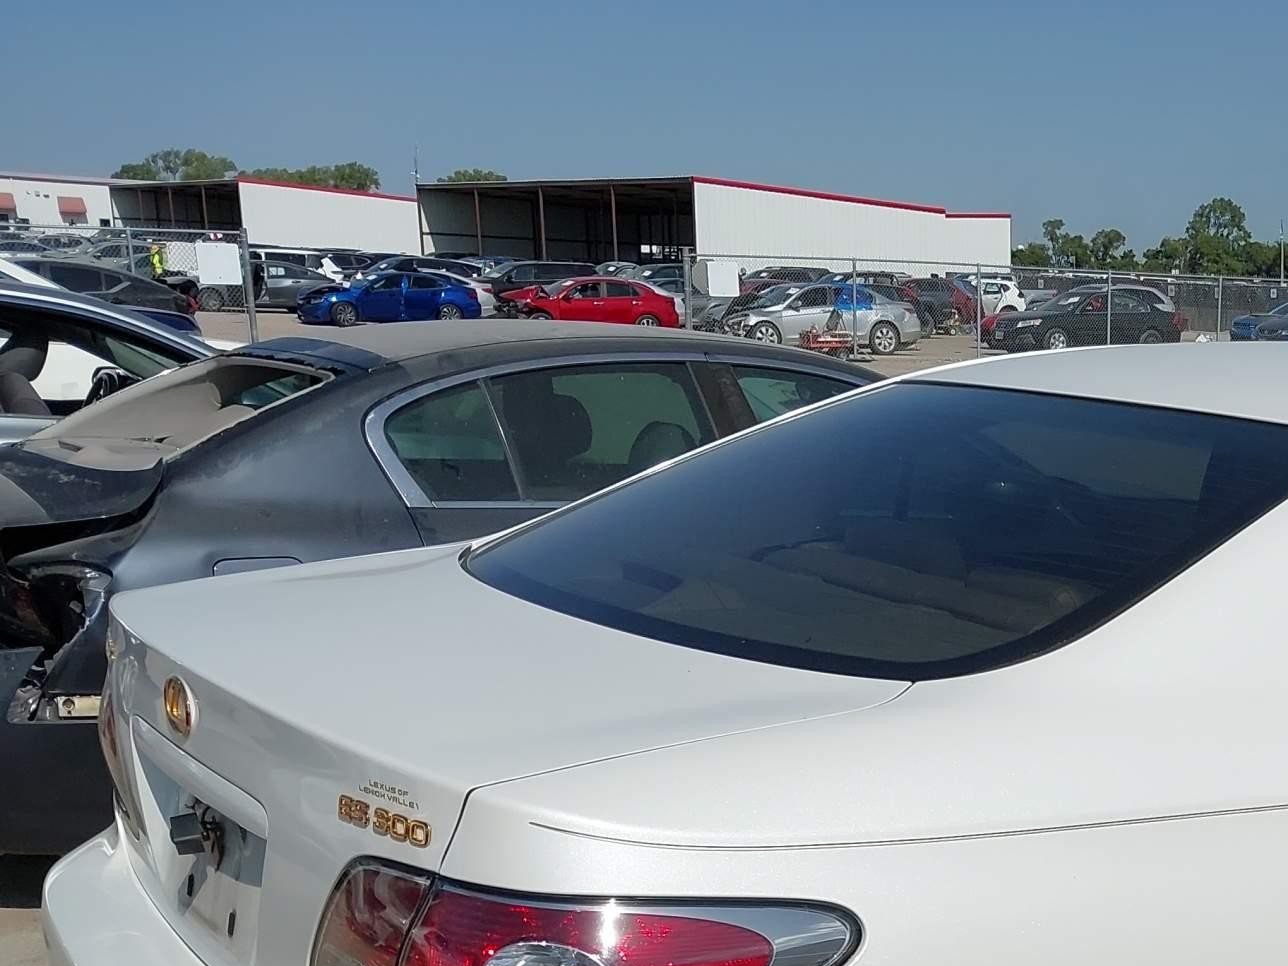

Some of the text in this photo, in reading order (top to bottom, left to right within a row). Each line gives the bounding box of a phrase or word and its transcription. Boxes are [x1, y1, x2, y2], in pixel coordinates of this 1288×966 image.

[368, 779, 397, 795] LEXUS
[338, 794, 432, 848] ES 300
